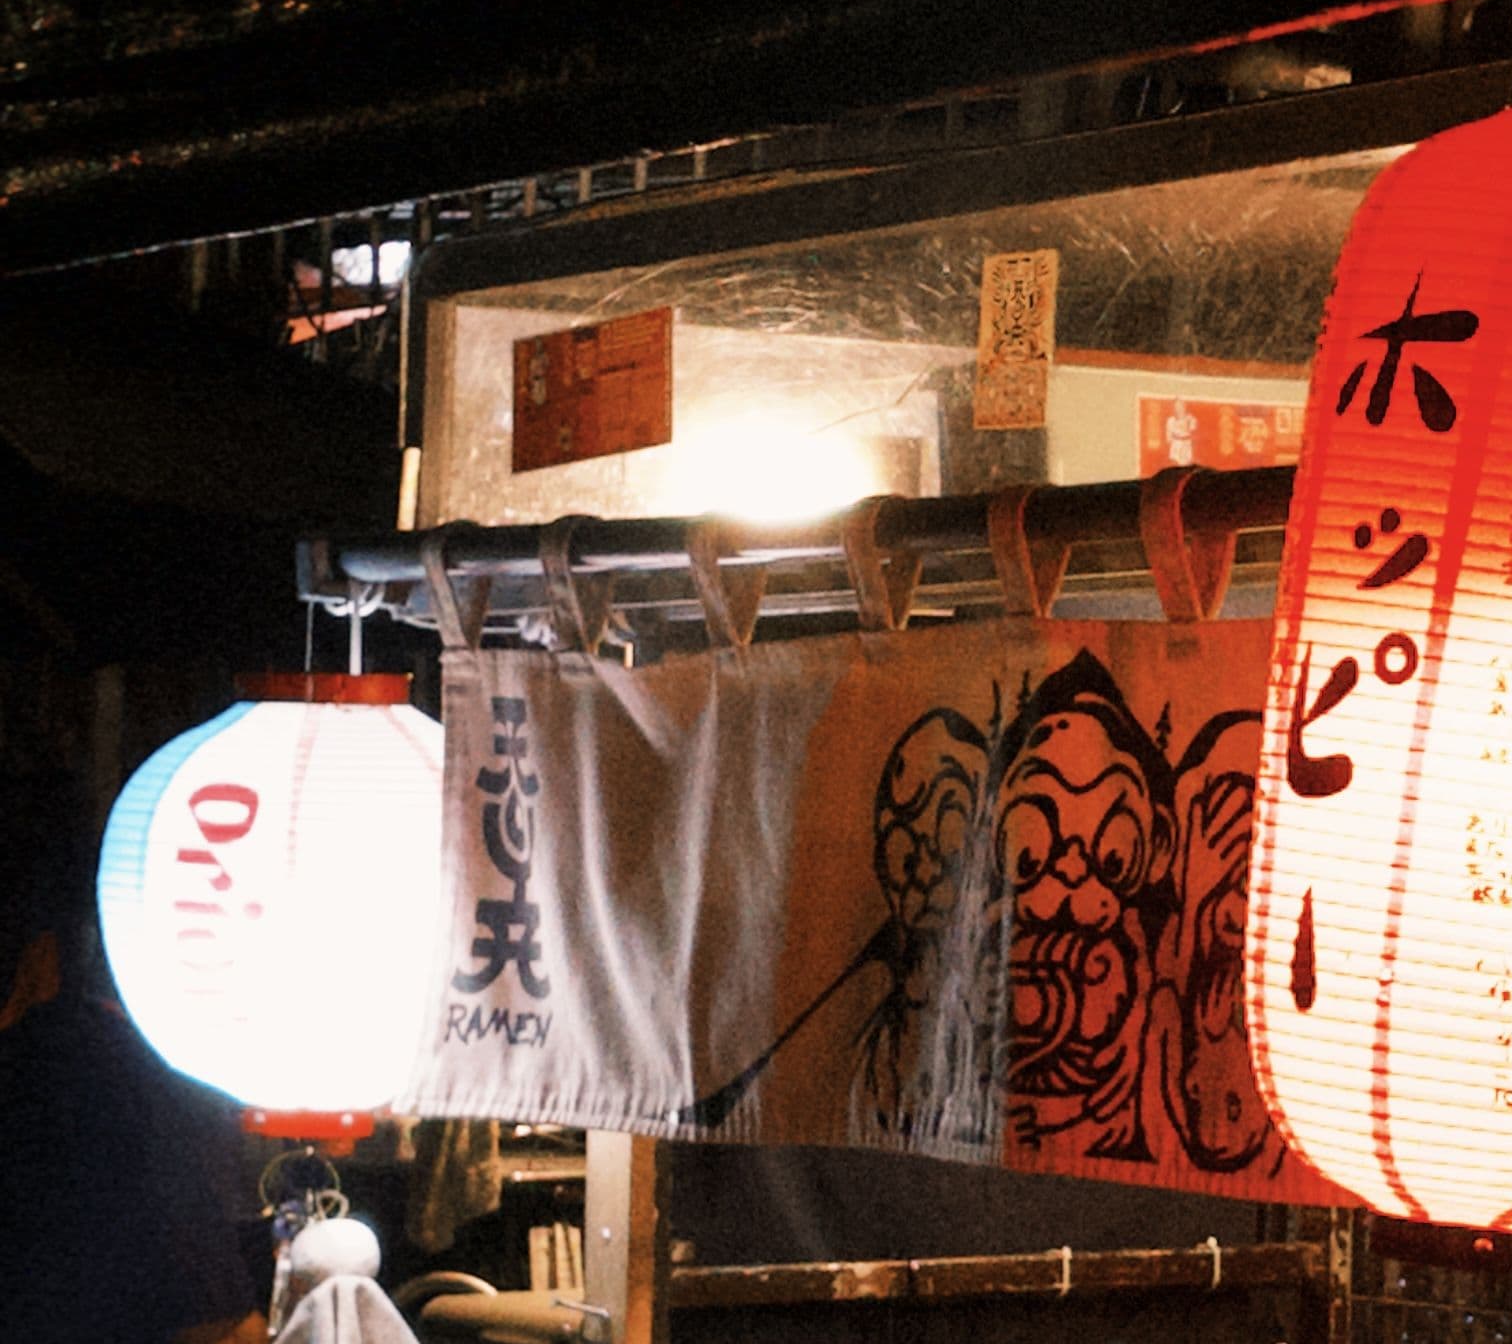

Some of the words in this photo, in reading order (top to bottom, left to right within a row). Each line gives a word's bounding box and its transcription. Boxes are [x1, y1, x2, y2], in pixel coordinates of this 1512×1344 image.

[1288, 267, 1480, 1013] ホッピー
[445, 1003, 553, 1047] RAMEN
